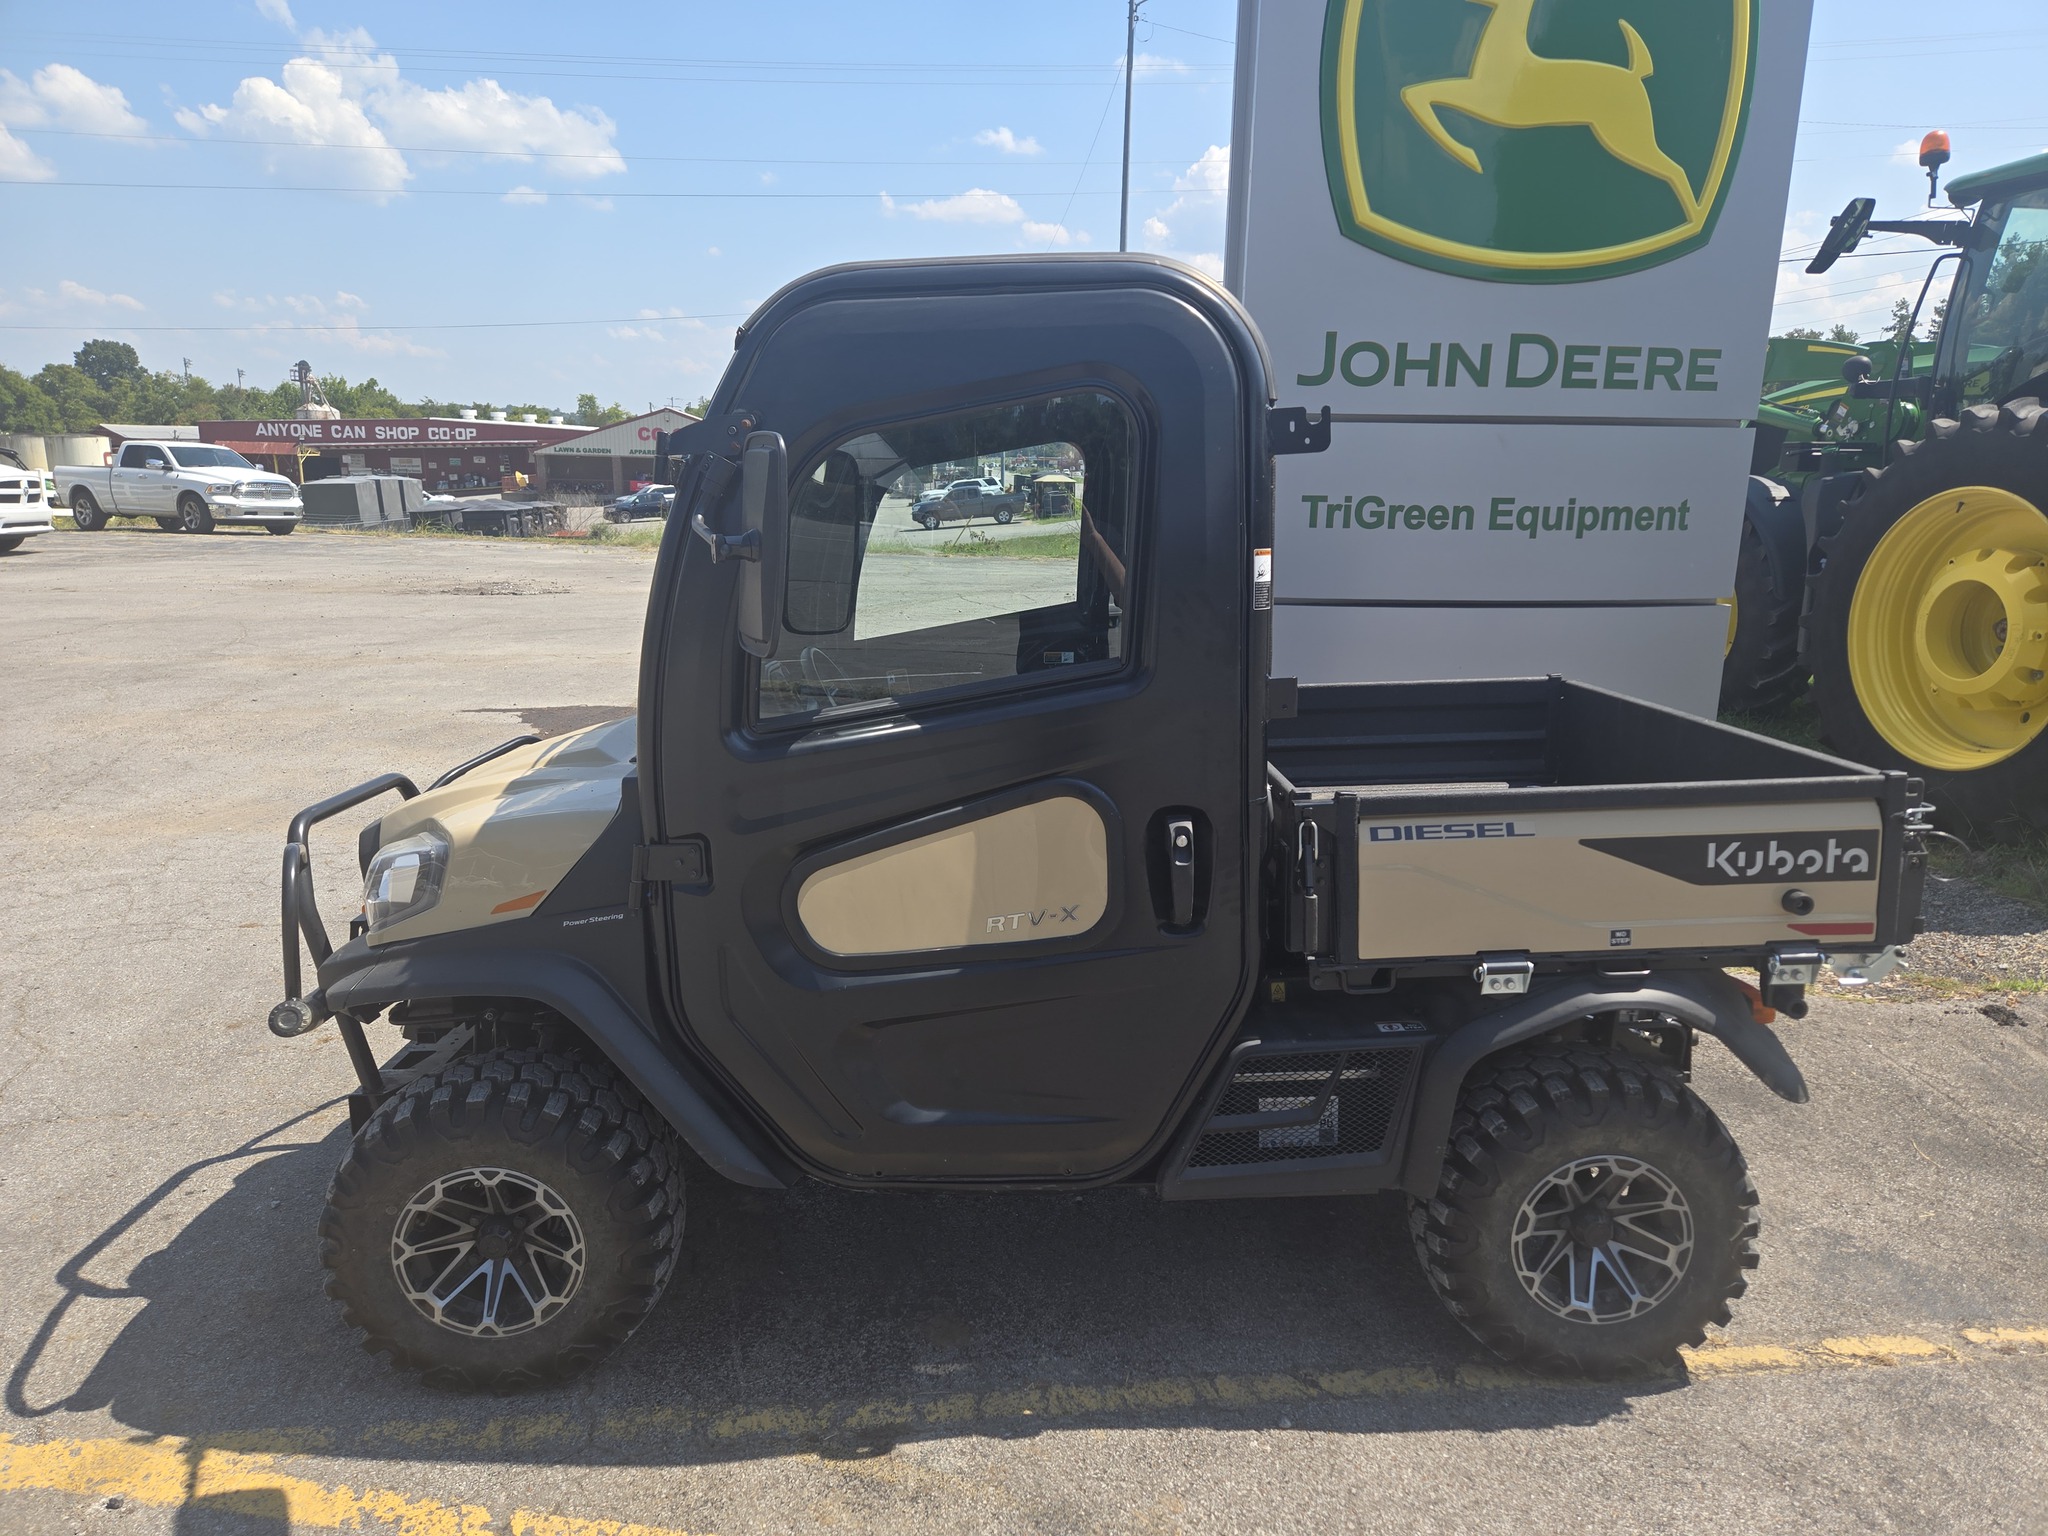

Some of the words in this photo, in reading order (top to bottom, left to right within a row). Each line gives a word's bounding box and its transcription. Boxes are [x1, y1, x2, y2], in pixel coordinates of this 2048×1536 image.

[1296, 331, 1493, 388] JOHN
[1505, 333, 1723, 391] DEERE
[255, 422, 323, 438] ANYONE
[330, 425, 366, 439] CAN
[374, 426, 420, 440] SHOP
[427, 427, 477, 440] CO-OP
[1301, 494, 1476, 531] TriGreen
[1487, 497, 1691, 539] Equipment
[1369, 821, 1536, 842] DIESEL
[1706, 838, 1870, 878] Kubota
[563, 919, 589, 927] Power
[589, 913, 624, 924] Steering
[986, 904, 1080, 934] RTV-X
